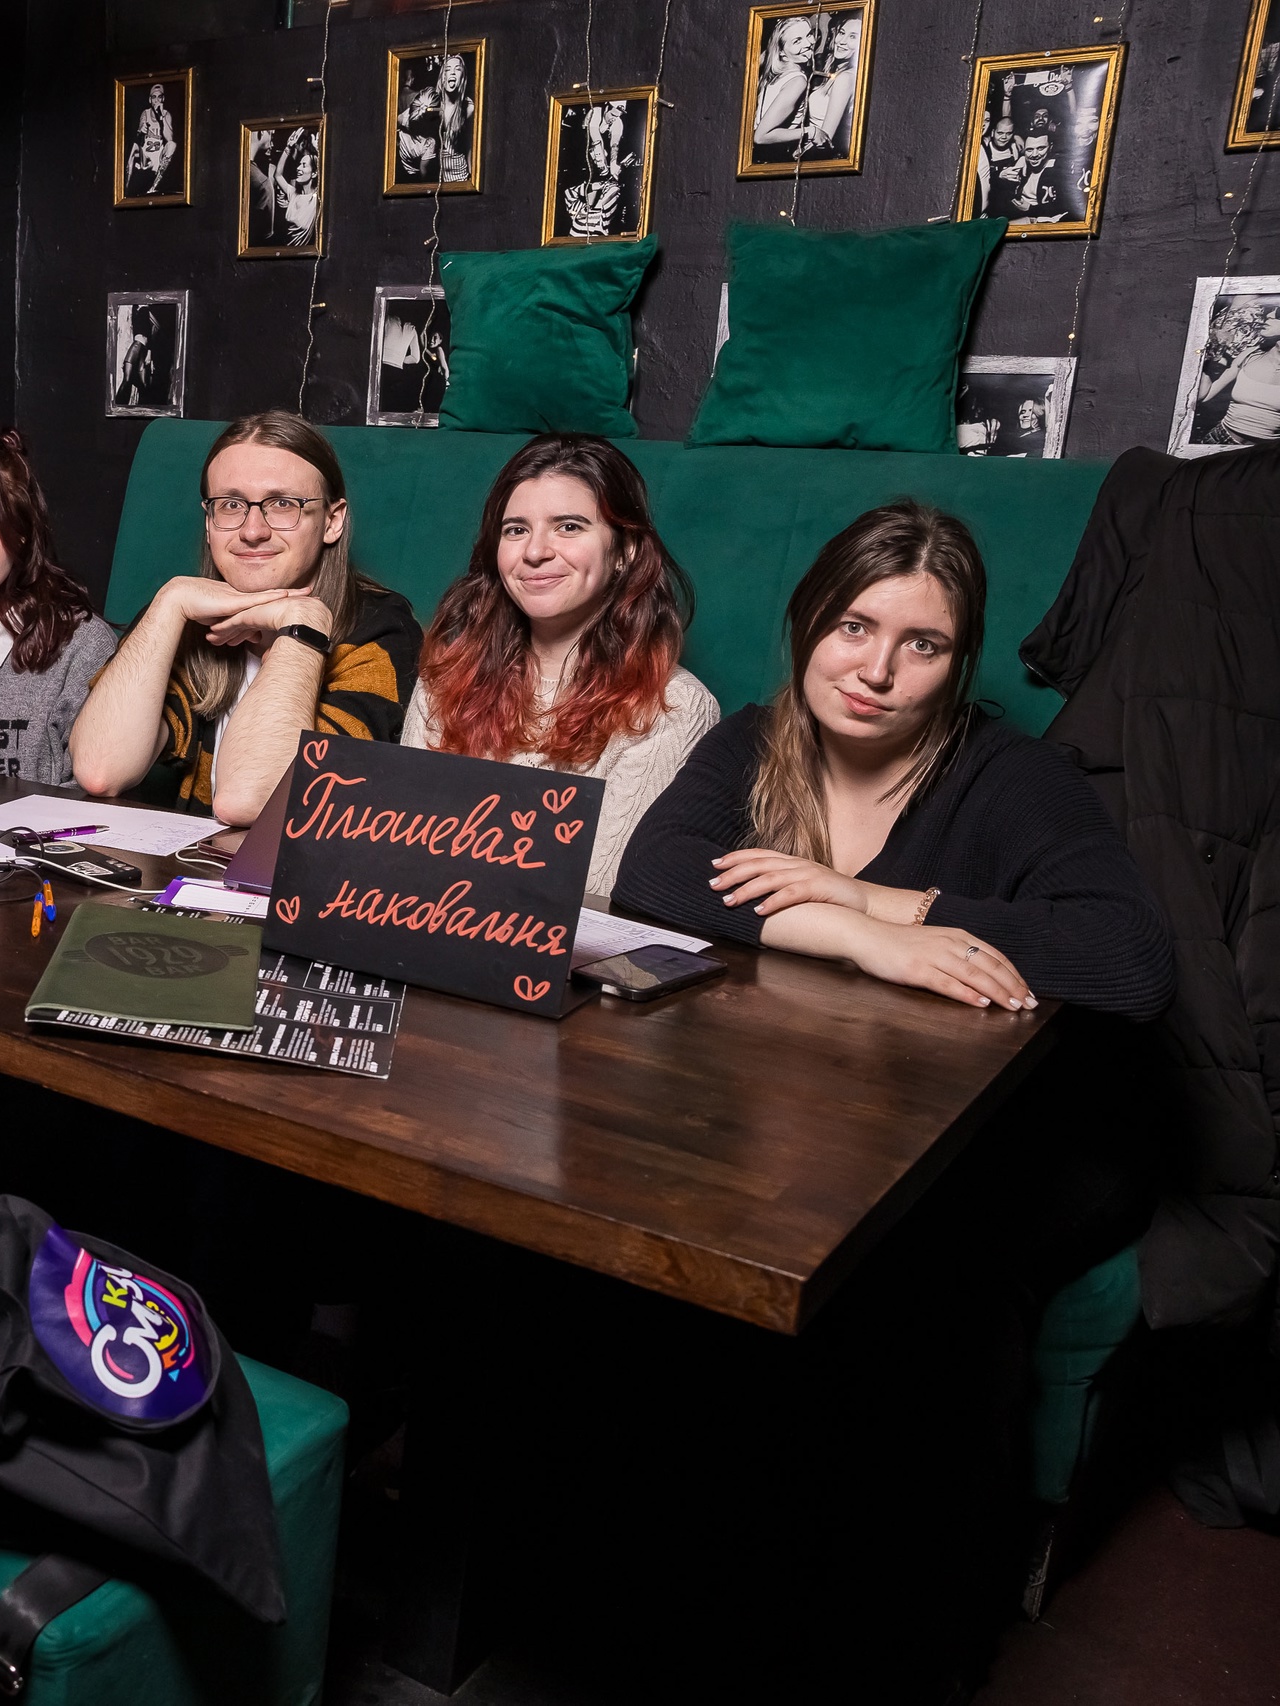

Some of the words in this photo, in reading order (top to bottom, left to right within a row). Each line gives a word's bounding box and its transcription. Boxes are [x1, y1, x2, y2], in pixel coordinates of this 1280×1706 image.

[285, 771, 546, 869] Плюшевая
[318, 880, 568, 956] наковальня
[108, 936, 163, 945] BAR
[107, 946, 202, 965] 1929
[144, 965, 204, 976] BAR
